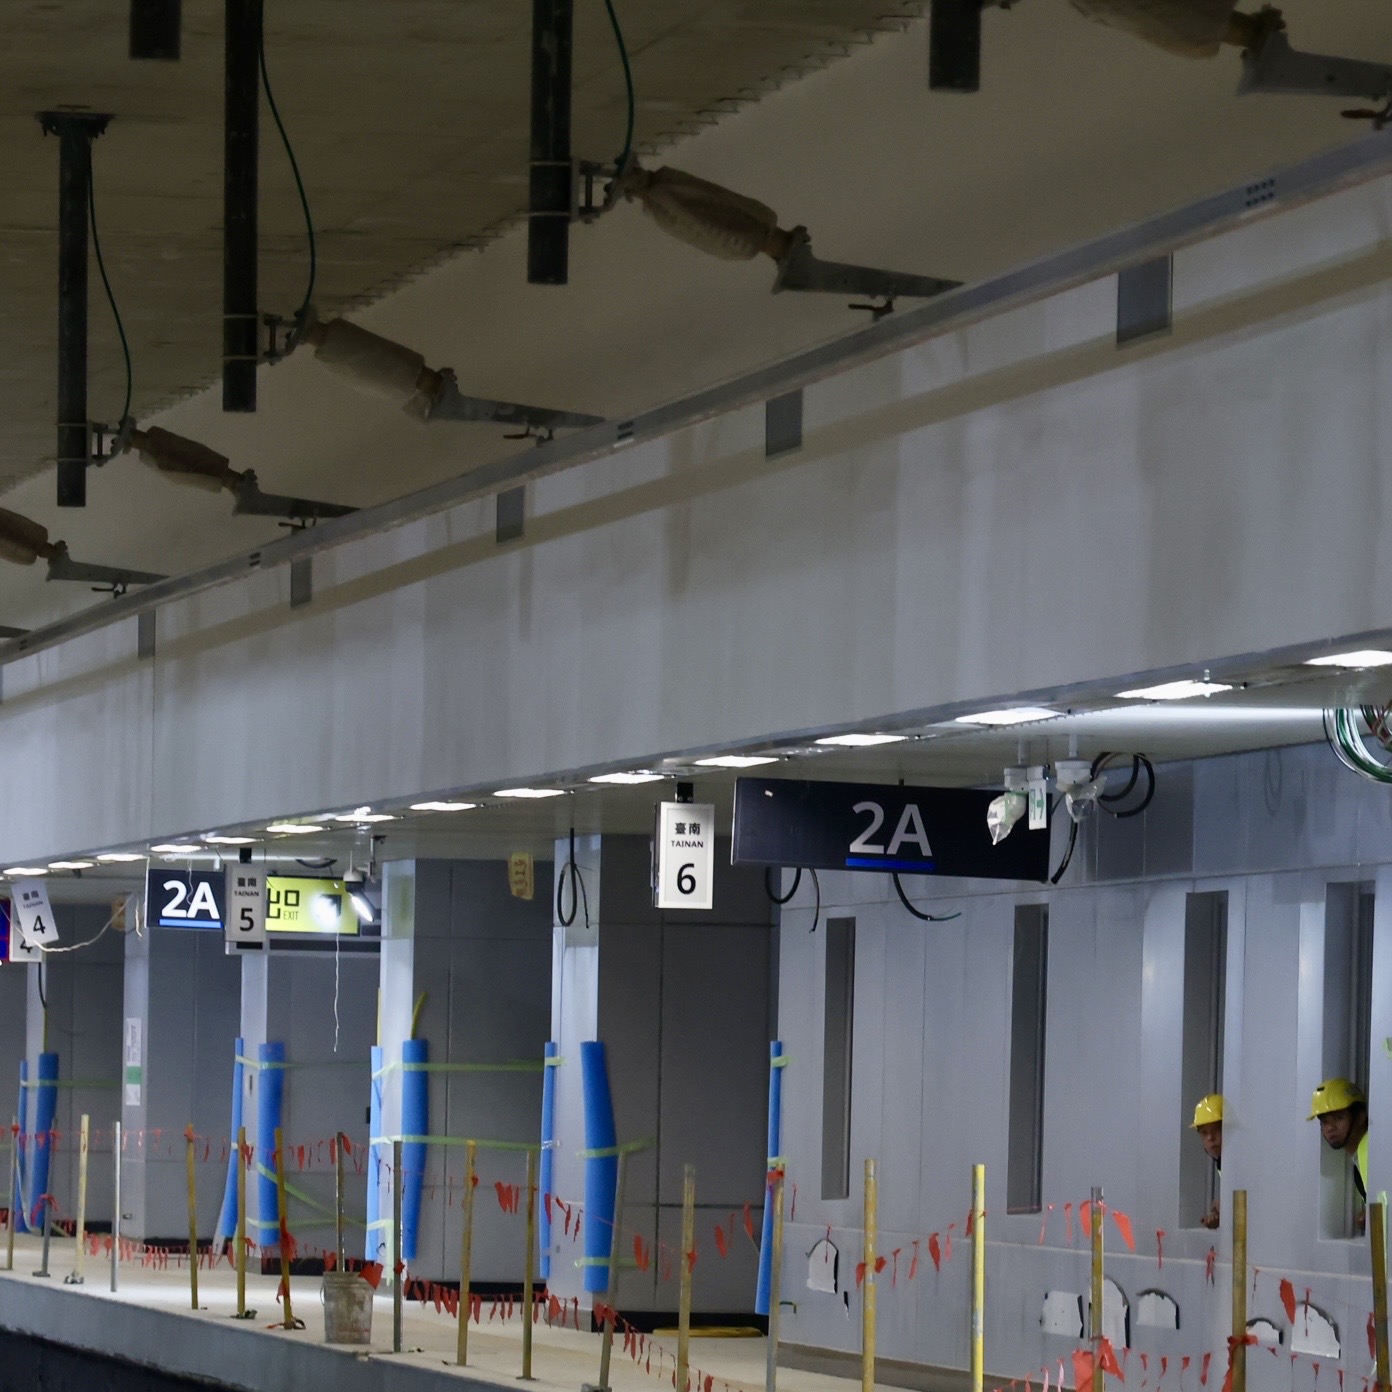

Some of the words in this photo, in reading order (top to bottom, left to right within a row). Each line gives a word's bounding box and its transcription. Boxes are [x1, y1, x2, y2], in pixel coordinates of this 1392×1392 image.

[674, 822, 701, 836] 臺南
[848, 802, 934, 858] 2A
[670, 840, 704, 848] TAINAN
[677, 862, 696, 895] 6
[161, 880, 221, 920] 2A
[33, 915, 46, 934] 4
[239, 907, 255, 932] 5
[283, 911, 300, 920] EXIT
